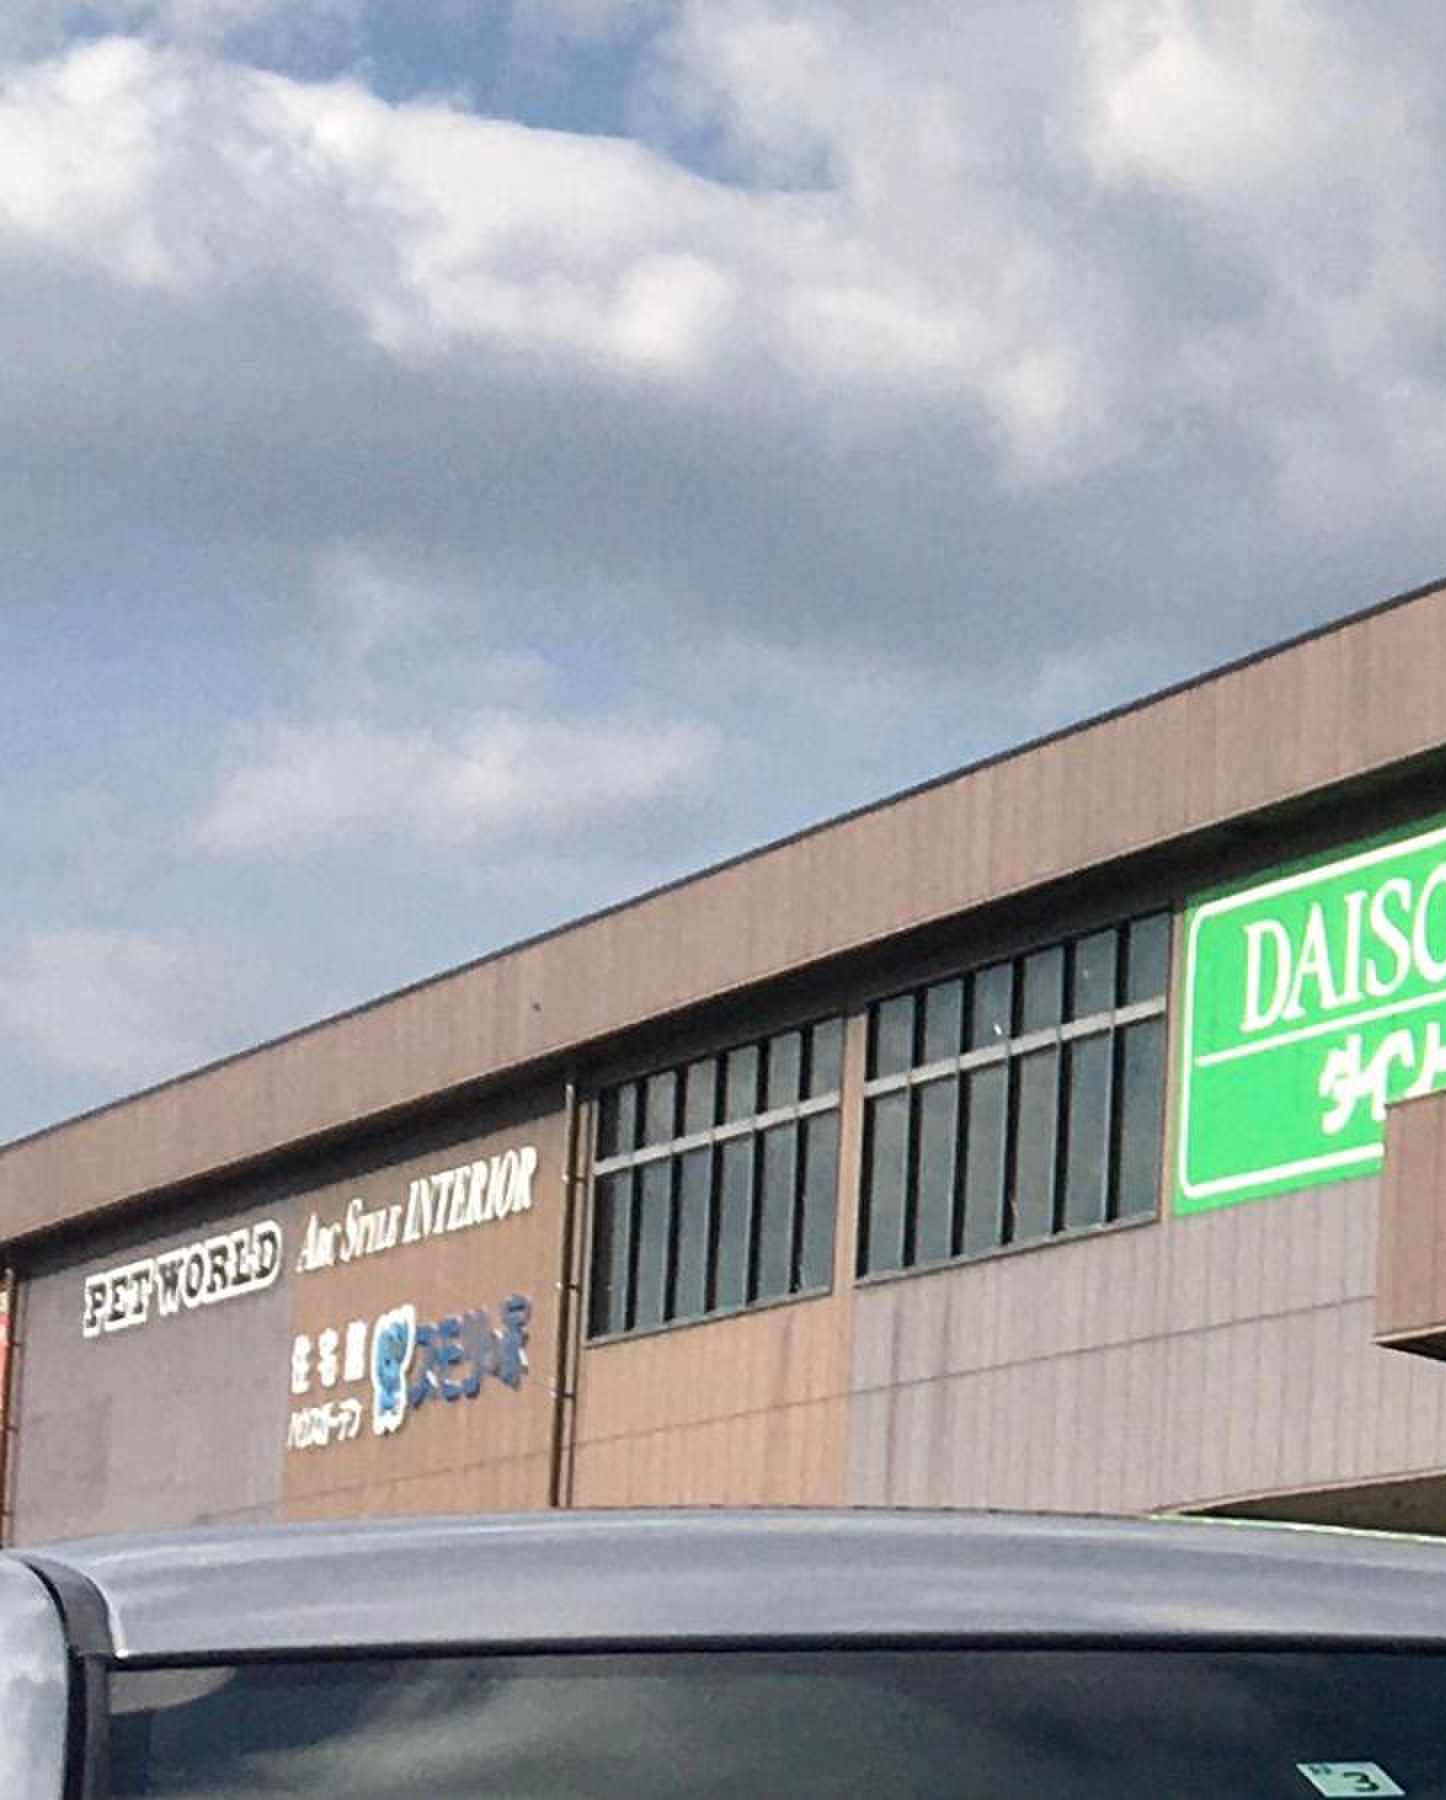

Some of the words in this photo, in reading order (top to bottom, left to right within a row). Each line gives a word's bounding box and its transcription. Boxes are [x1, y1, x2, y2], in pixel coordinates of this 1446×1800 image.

[402, 1145, 537, 1244] INTERIOR
[84, 1262, 153, 1334] PET
[157, 1223, 281, 1310] WORLD
[1342, 1771, 1380, 1793] 3
